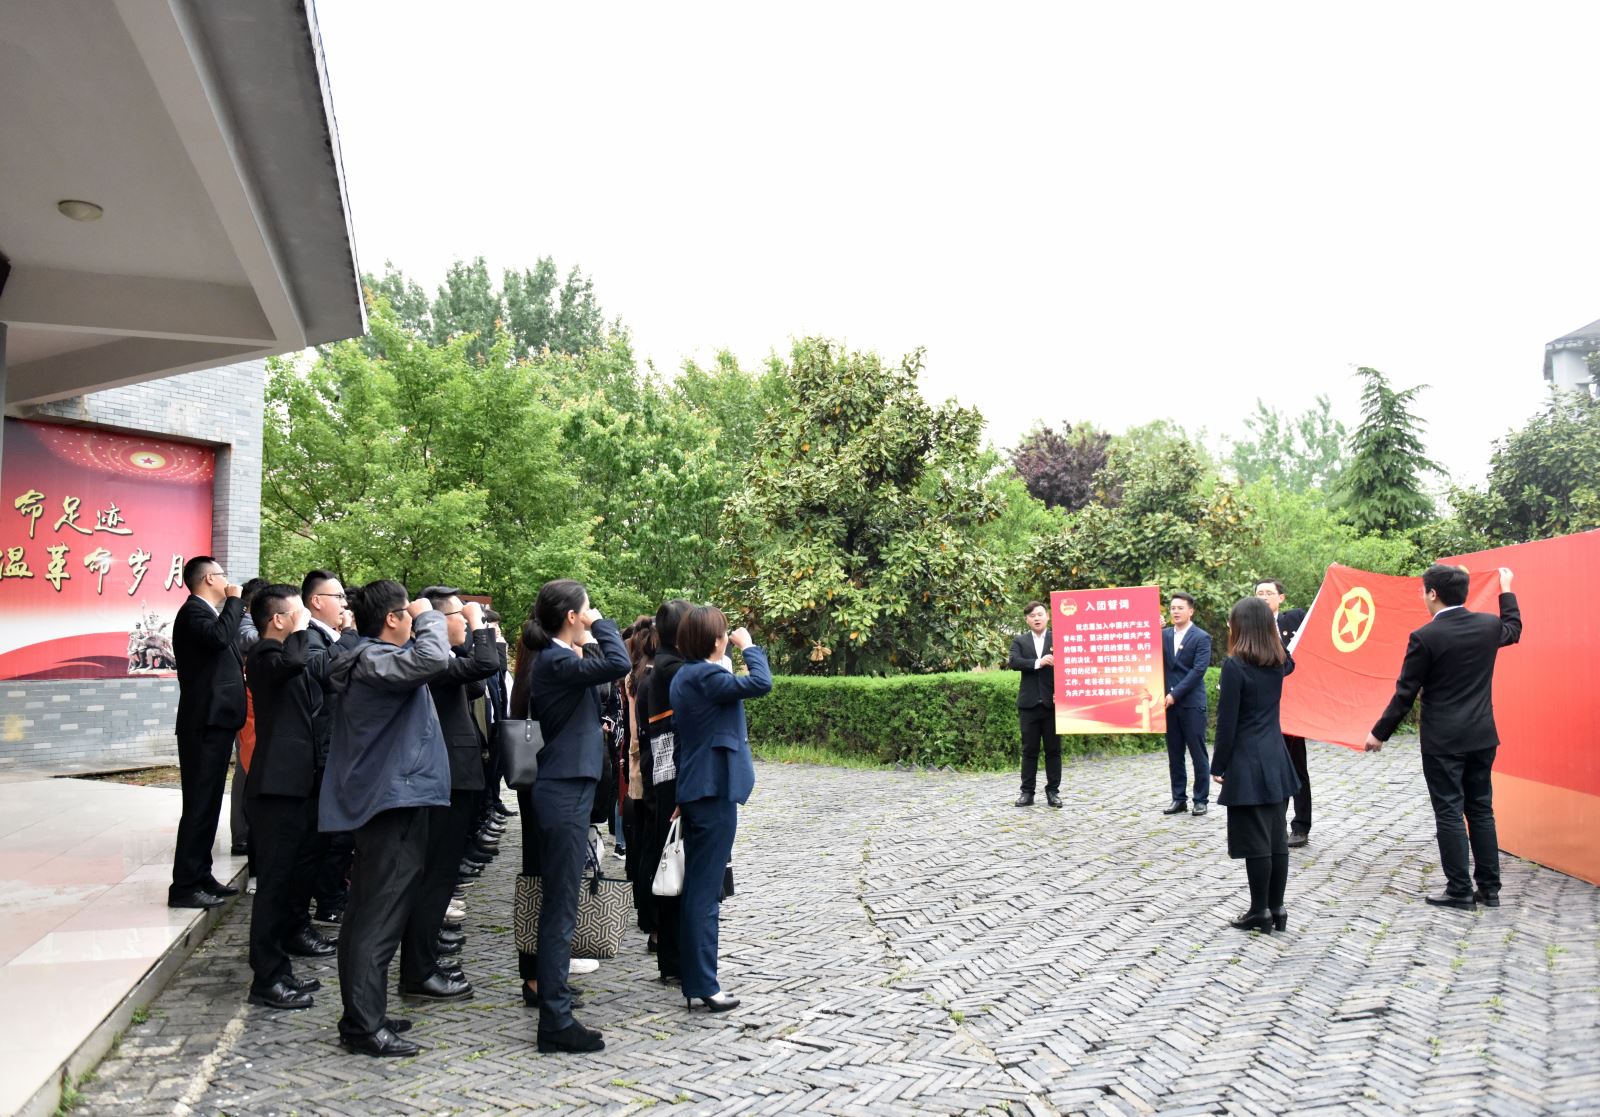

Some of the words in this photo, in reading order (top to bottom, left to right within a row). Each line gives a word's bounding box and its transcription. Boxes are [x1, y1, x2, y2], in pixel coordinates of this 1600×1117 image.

[15, 489, 133, 538] 命足迹
[1085, 598, 1130, 611] 入团誓词
